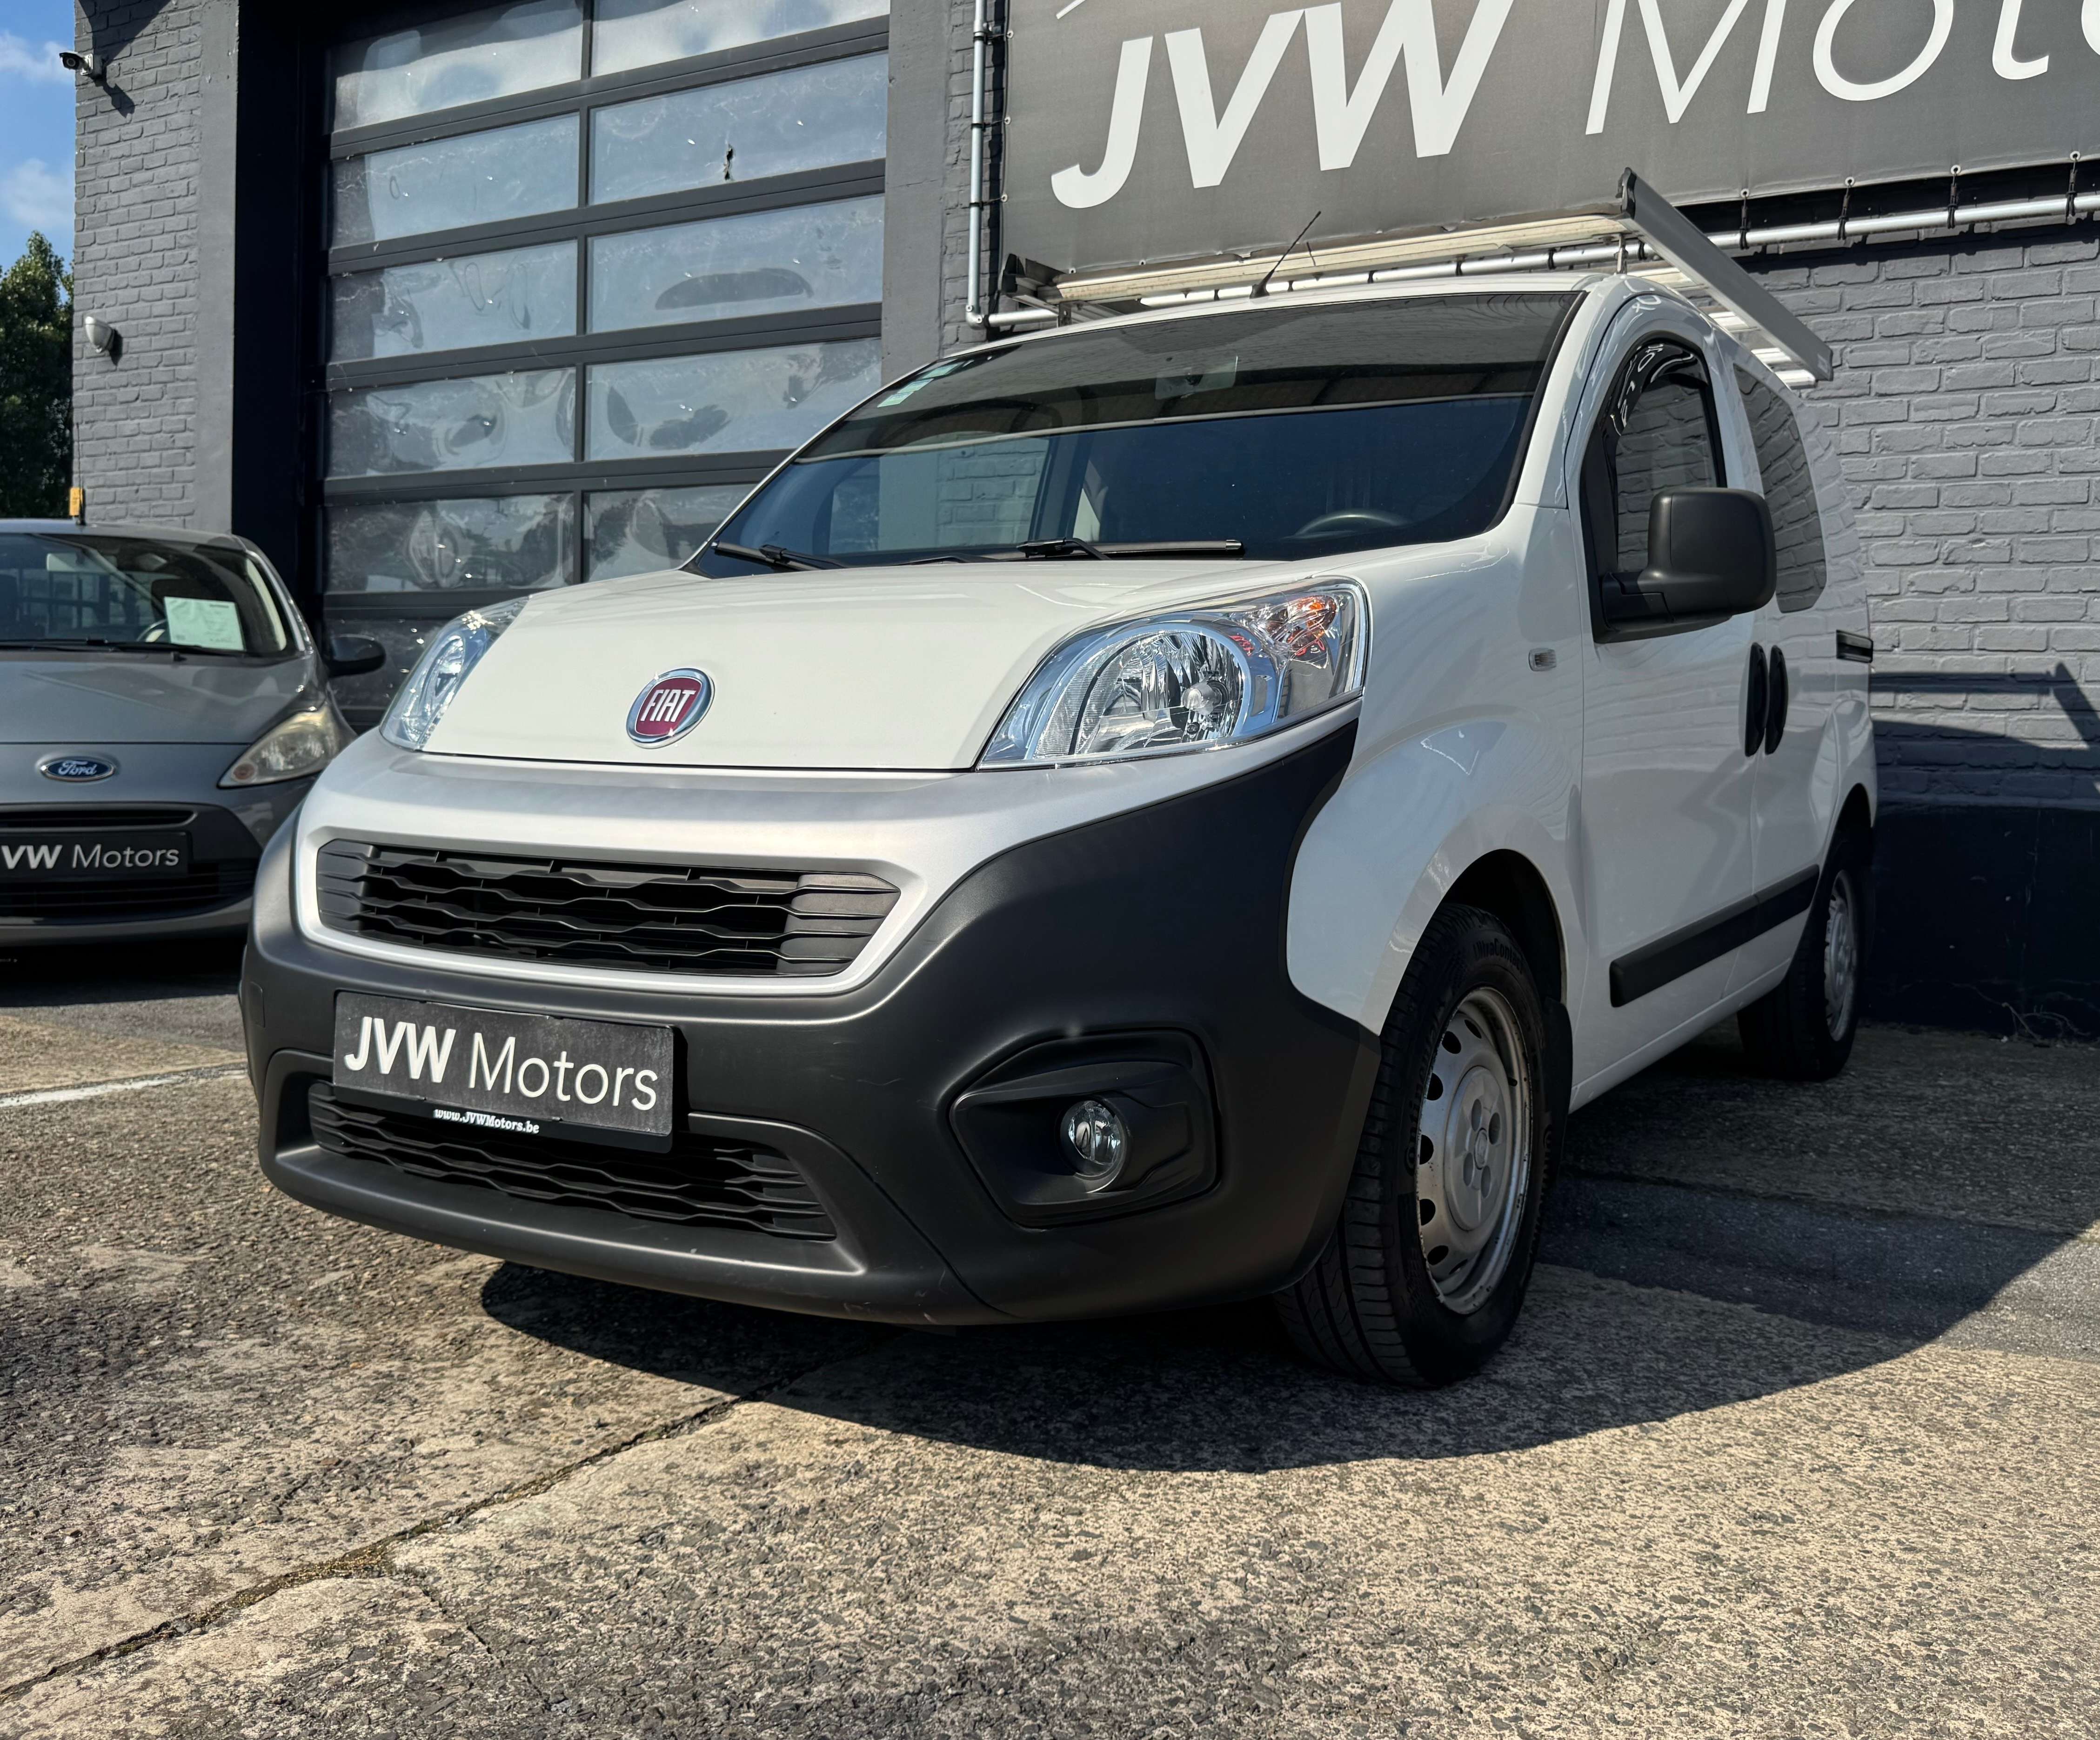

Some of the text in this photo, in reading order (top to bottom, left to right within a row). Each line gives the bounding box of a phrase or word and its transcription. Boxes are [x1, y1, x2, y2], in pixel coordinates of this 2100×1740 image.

[1050, 0, 2100, 209] JVW Mo
[640, 689, 696, 722] FIAT
[58, 760, 97, 776] Ford
[72, 843, 180, 868] Motors
[344, 1016, 658, 1111] JVW Motors
[433, 1108, 540, 1134] www.JVWMotors.be
